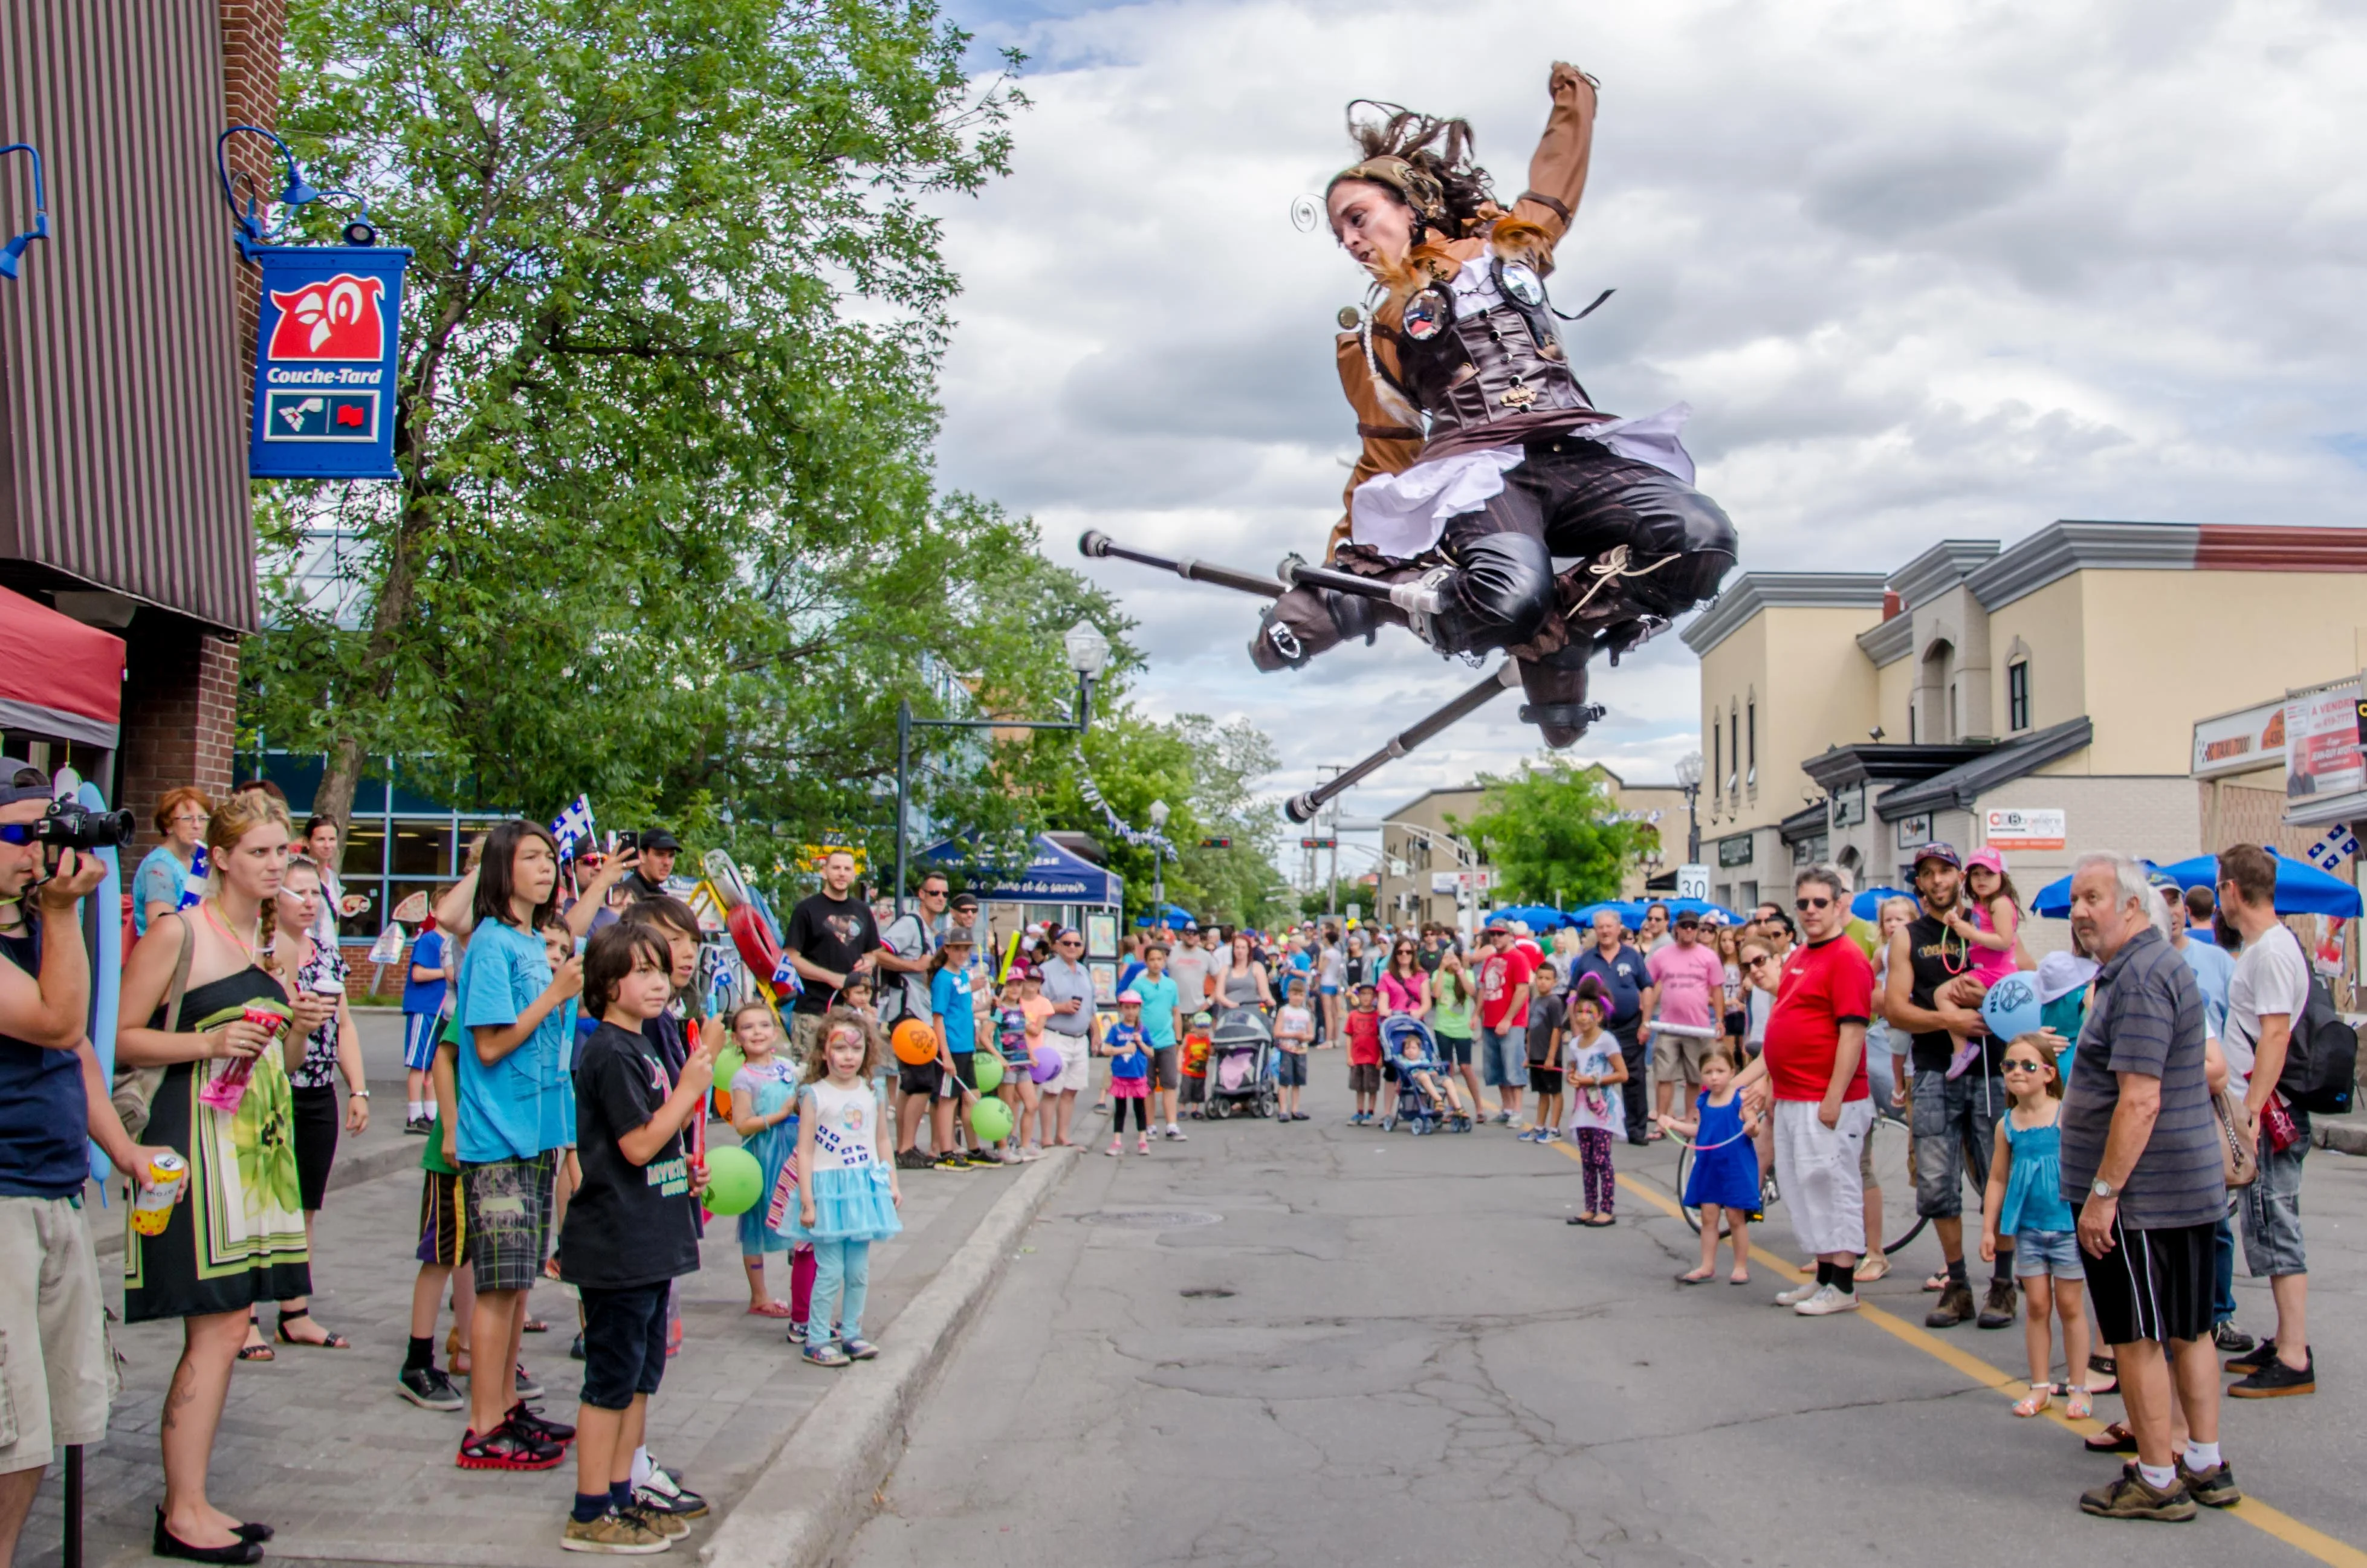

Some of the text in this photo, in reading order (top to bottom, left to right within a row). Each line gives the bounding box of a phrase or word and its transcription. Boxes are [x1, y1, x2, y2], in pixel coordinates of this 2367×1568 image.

[267, 367, 383, 384] Couche-Tard
[2216, 740, 2232, 758] TAXI
[1022, 880, 1034, 892] et
[1035, 880, 1049, 893] de
[1050, 881, 1087, 894] savoir
[1682, 880, 1706, 899] 30
